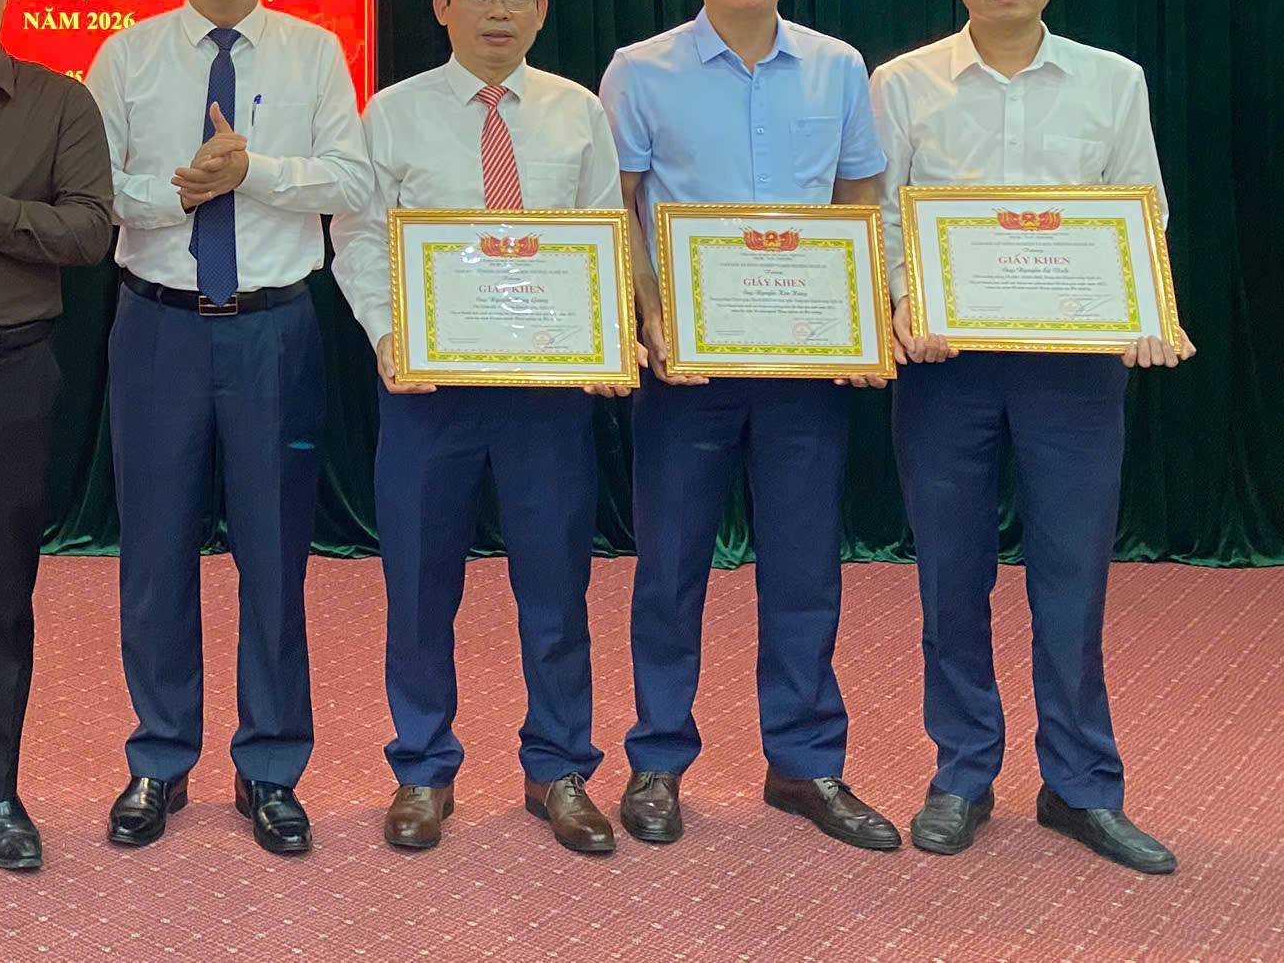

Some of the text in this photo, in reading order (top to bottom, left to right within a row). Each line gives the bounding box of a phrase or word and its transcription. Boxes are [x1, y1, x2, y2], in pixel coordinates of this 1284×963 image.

[23, 7, 136, 30] NĂM 2026
[998, 253, 1071, 265] GIẤY KHEN
[743, 275, 806, 287] GIẤY KHEN
